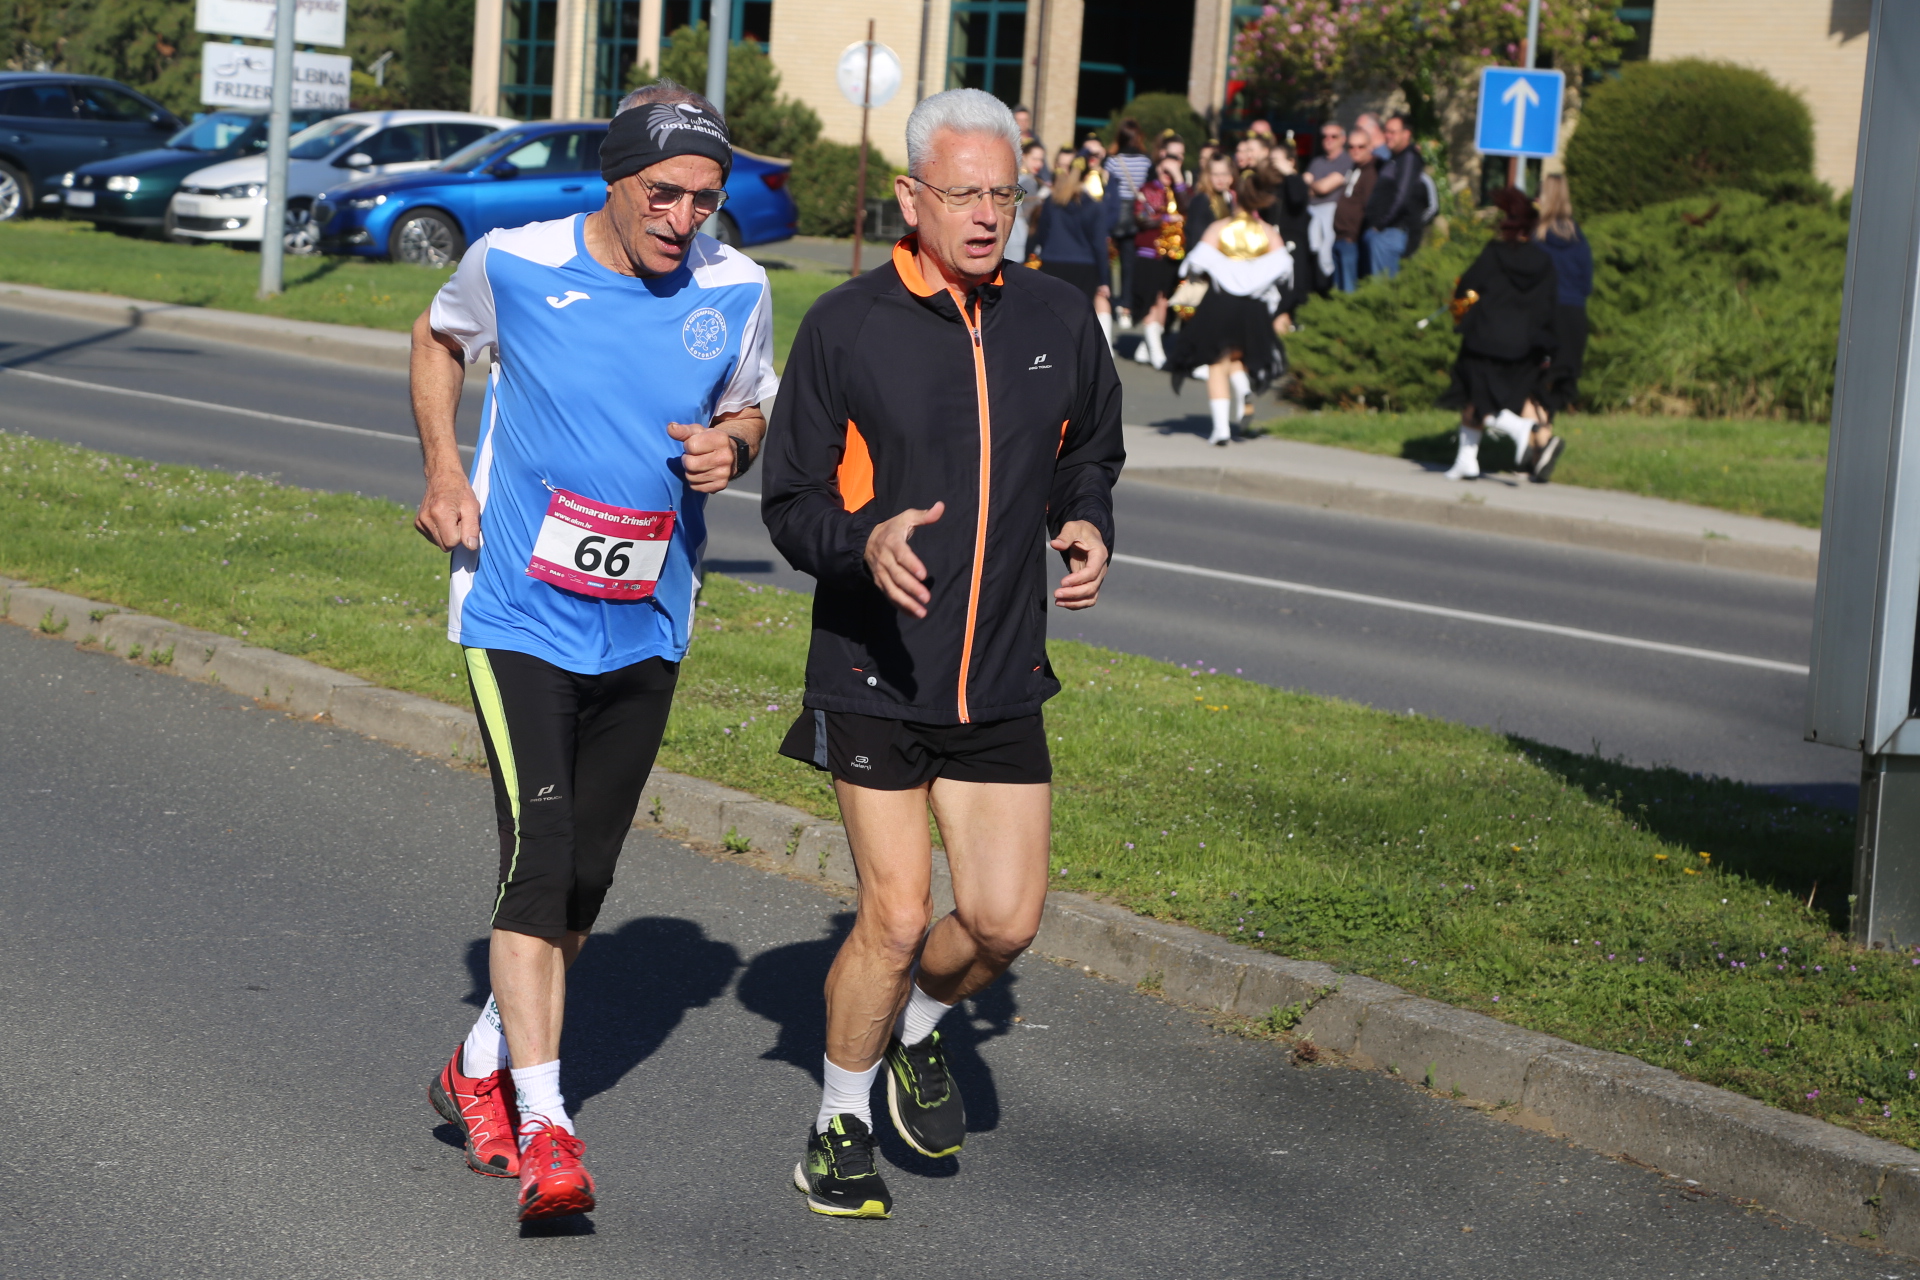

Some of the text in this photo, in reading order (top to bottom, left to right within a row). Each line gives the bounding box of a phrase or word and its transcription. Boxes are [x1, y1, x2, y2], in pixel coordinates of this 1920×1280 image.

[293, 66, 346, 86] LBINA
[558, 494, 652, 527] Polumaraton Zrinski
[574, 535, 635, 577] 66
